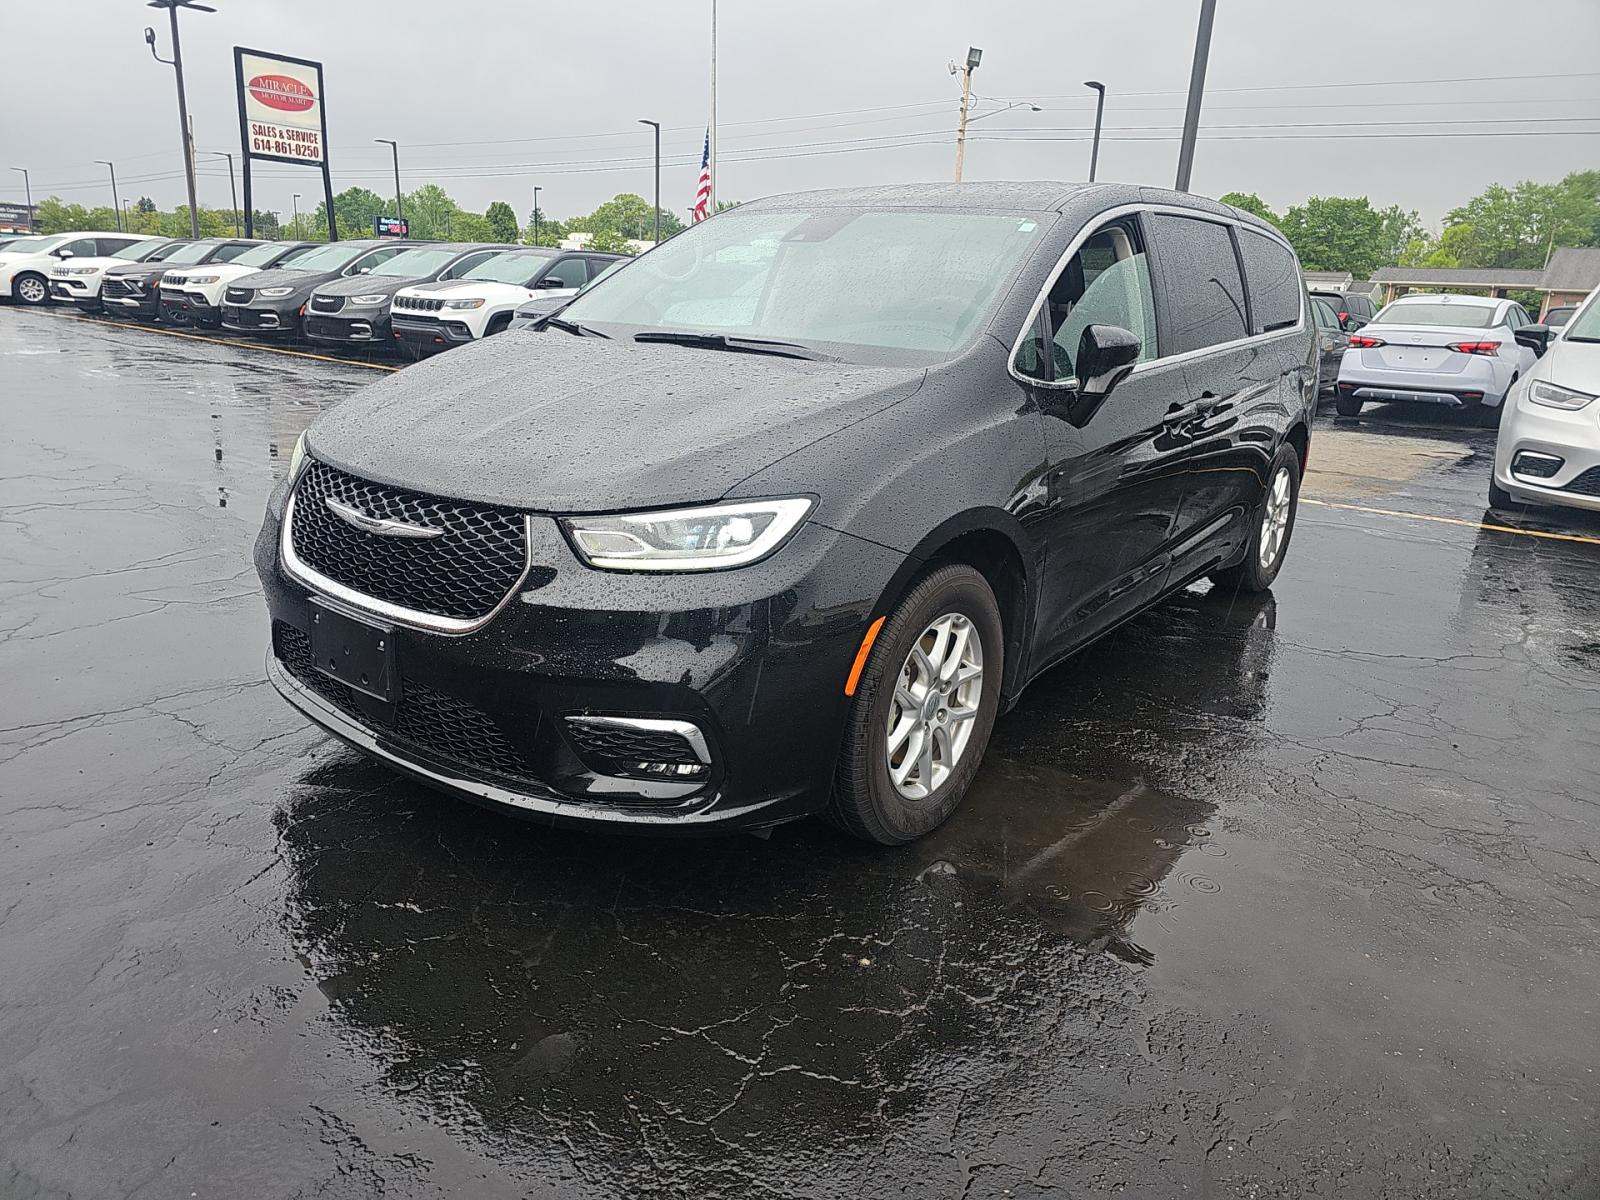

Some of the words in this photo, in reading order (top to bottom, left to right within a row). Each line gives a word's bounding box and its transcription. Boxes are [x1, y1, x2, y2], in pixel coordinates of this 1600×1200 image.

[259, 79, 308, 95] MIRACLE
[252, 124, 277, 138] SALES
[279, 130, 285, 140] &
[286, 130, 318, 144] SERVICE
[254, 138, 319, 158] 614-861-0250
